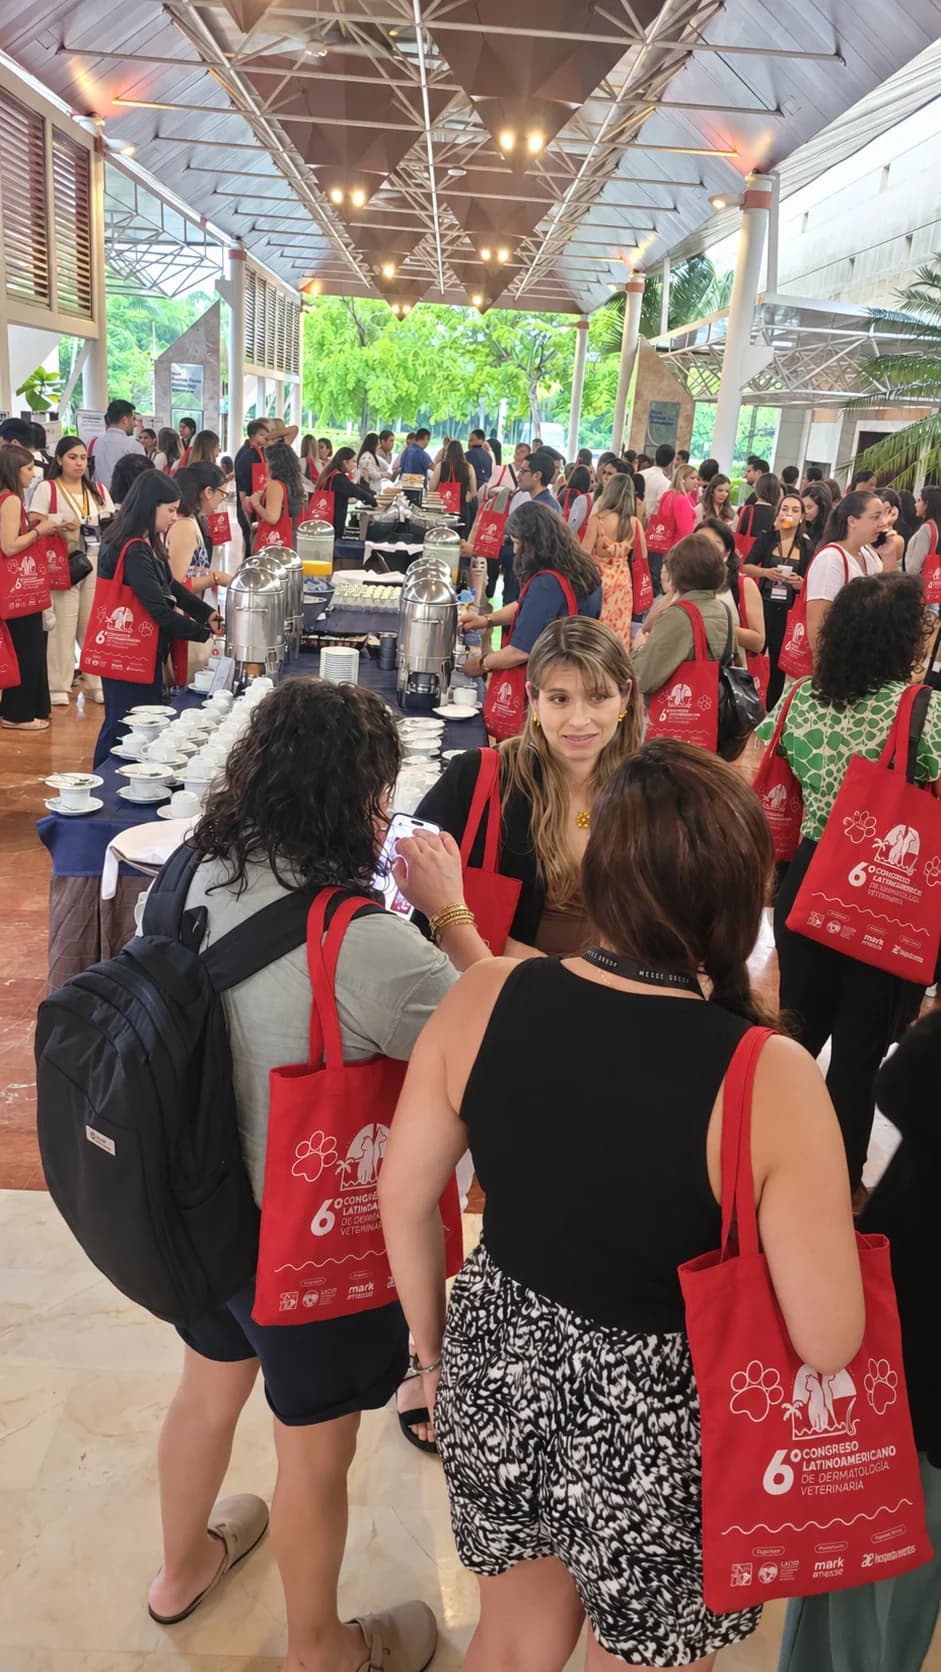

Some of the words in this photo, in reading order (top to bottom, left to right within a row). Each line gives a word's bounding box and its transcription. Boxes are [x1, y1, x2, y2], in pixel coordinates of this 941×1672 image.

[343, 1191, 377, 1206] CONGRE
[348, 1281, 375, 1294] mark
[802, 1440, 859, 1460] CONGRESO
[802, 1445, 897, 1472] LATINOAMERICANO
[801, 1473, 815, 1485] DE
[800, 1480, 865, 1496] VETERINARIA
[814, 1557, 845, 1571] mark
